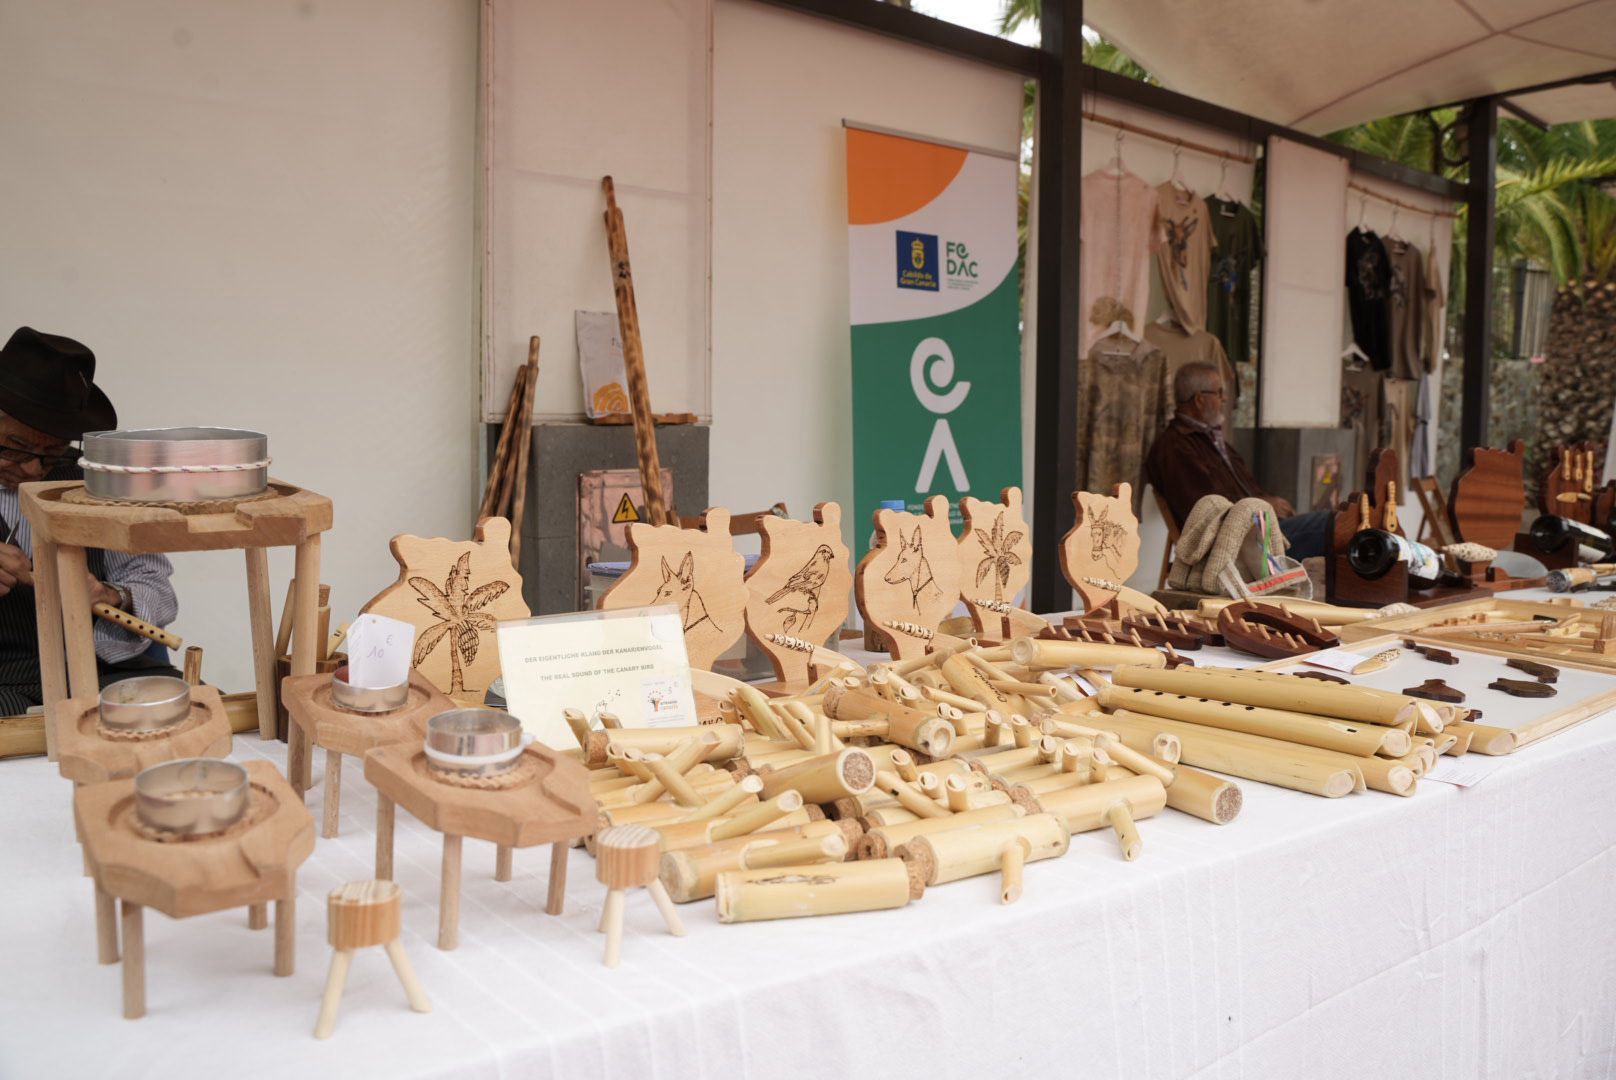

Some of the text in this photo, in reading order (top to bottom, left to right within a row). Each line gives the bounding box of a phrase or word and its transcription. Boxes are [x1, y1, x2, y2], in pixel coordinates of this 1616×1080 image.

[902, 269, 933, 280] Cabildo de
[899, 277, 914, 285] Gran
[915, 278, 937, 288] Canaria
[524, 656, 538, 664] DER
[580, 650, 601, 658] KLANG
[571, 670, 593, 678] SOUND
[616, 665, 639, 673] CANARY
[640, 663, 654, 671] BIRD
